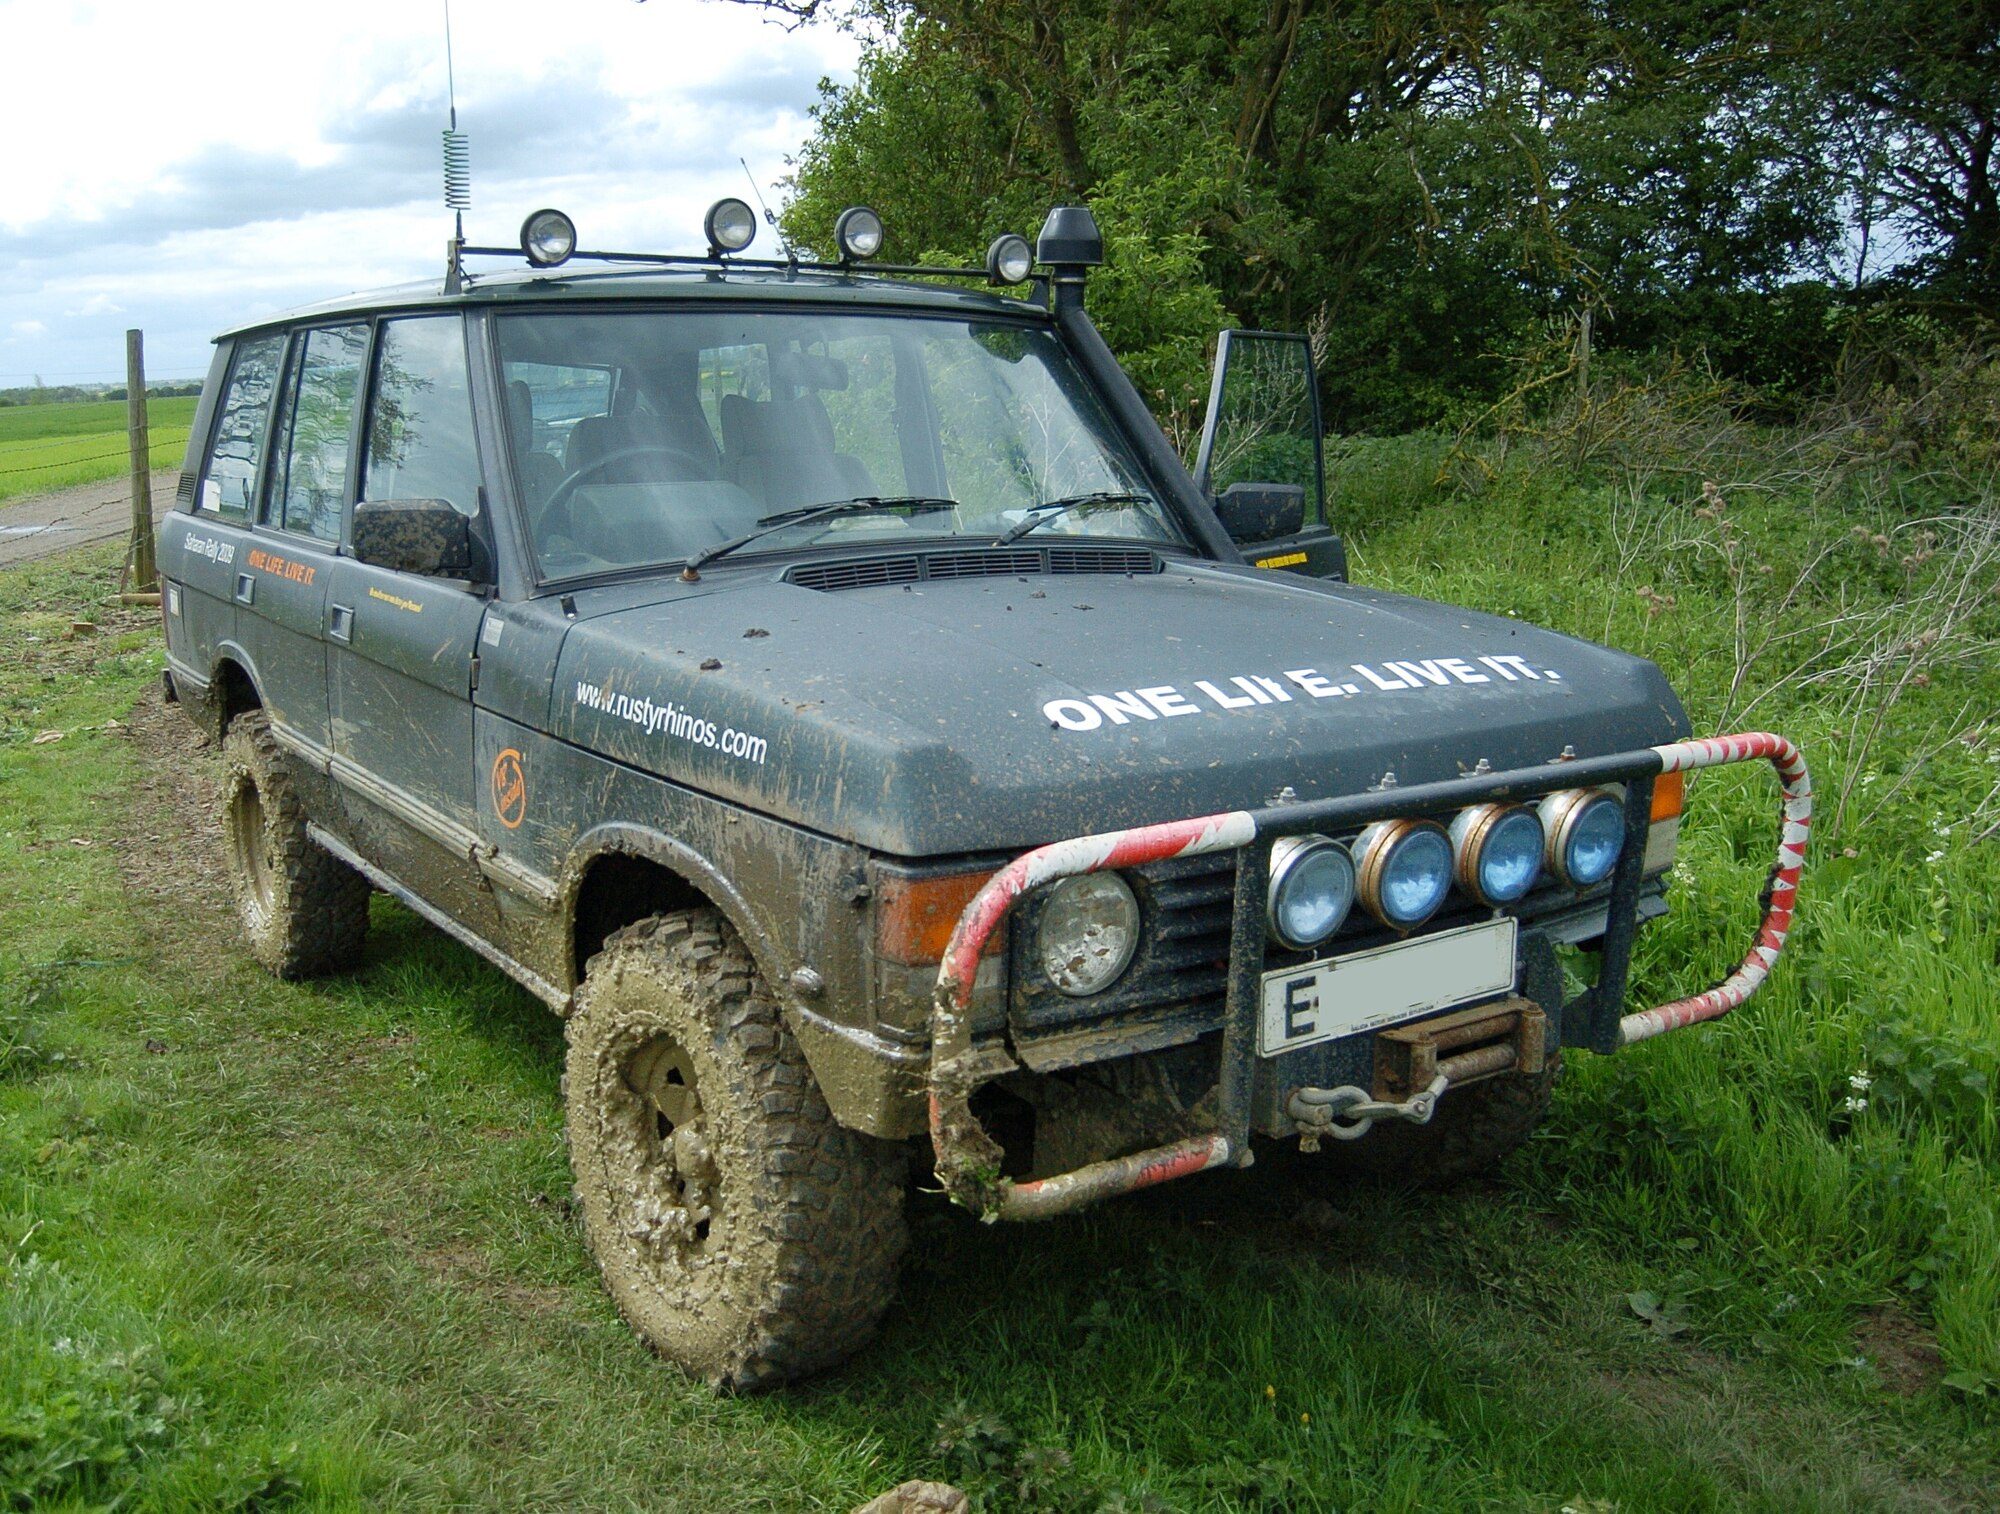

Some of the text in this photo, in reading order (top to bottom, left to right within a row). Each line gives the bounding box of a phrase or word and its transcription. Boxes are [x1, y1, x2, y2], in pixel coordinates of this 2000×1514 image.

[248, 549, 267, 569] ONE
[284, 561, 306, 582] LIVE
[576, 681, 768, 765] www.rustyrhinos.com
[1042, 685, 1202, 732] ONE
[1350, 658, 1491, 691] LIVE
